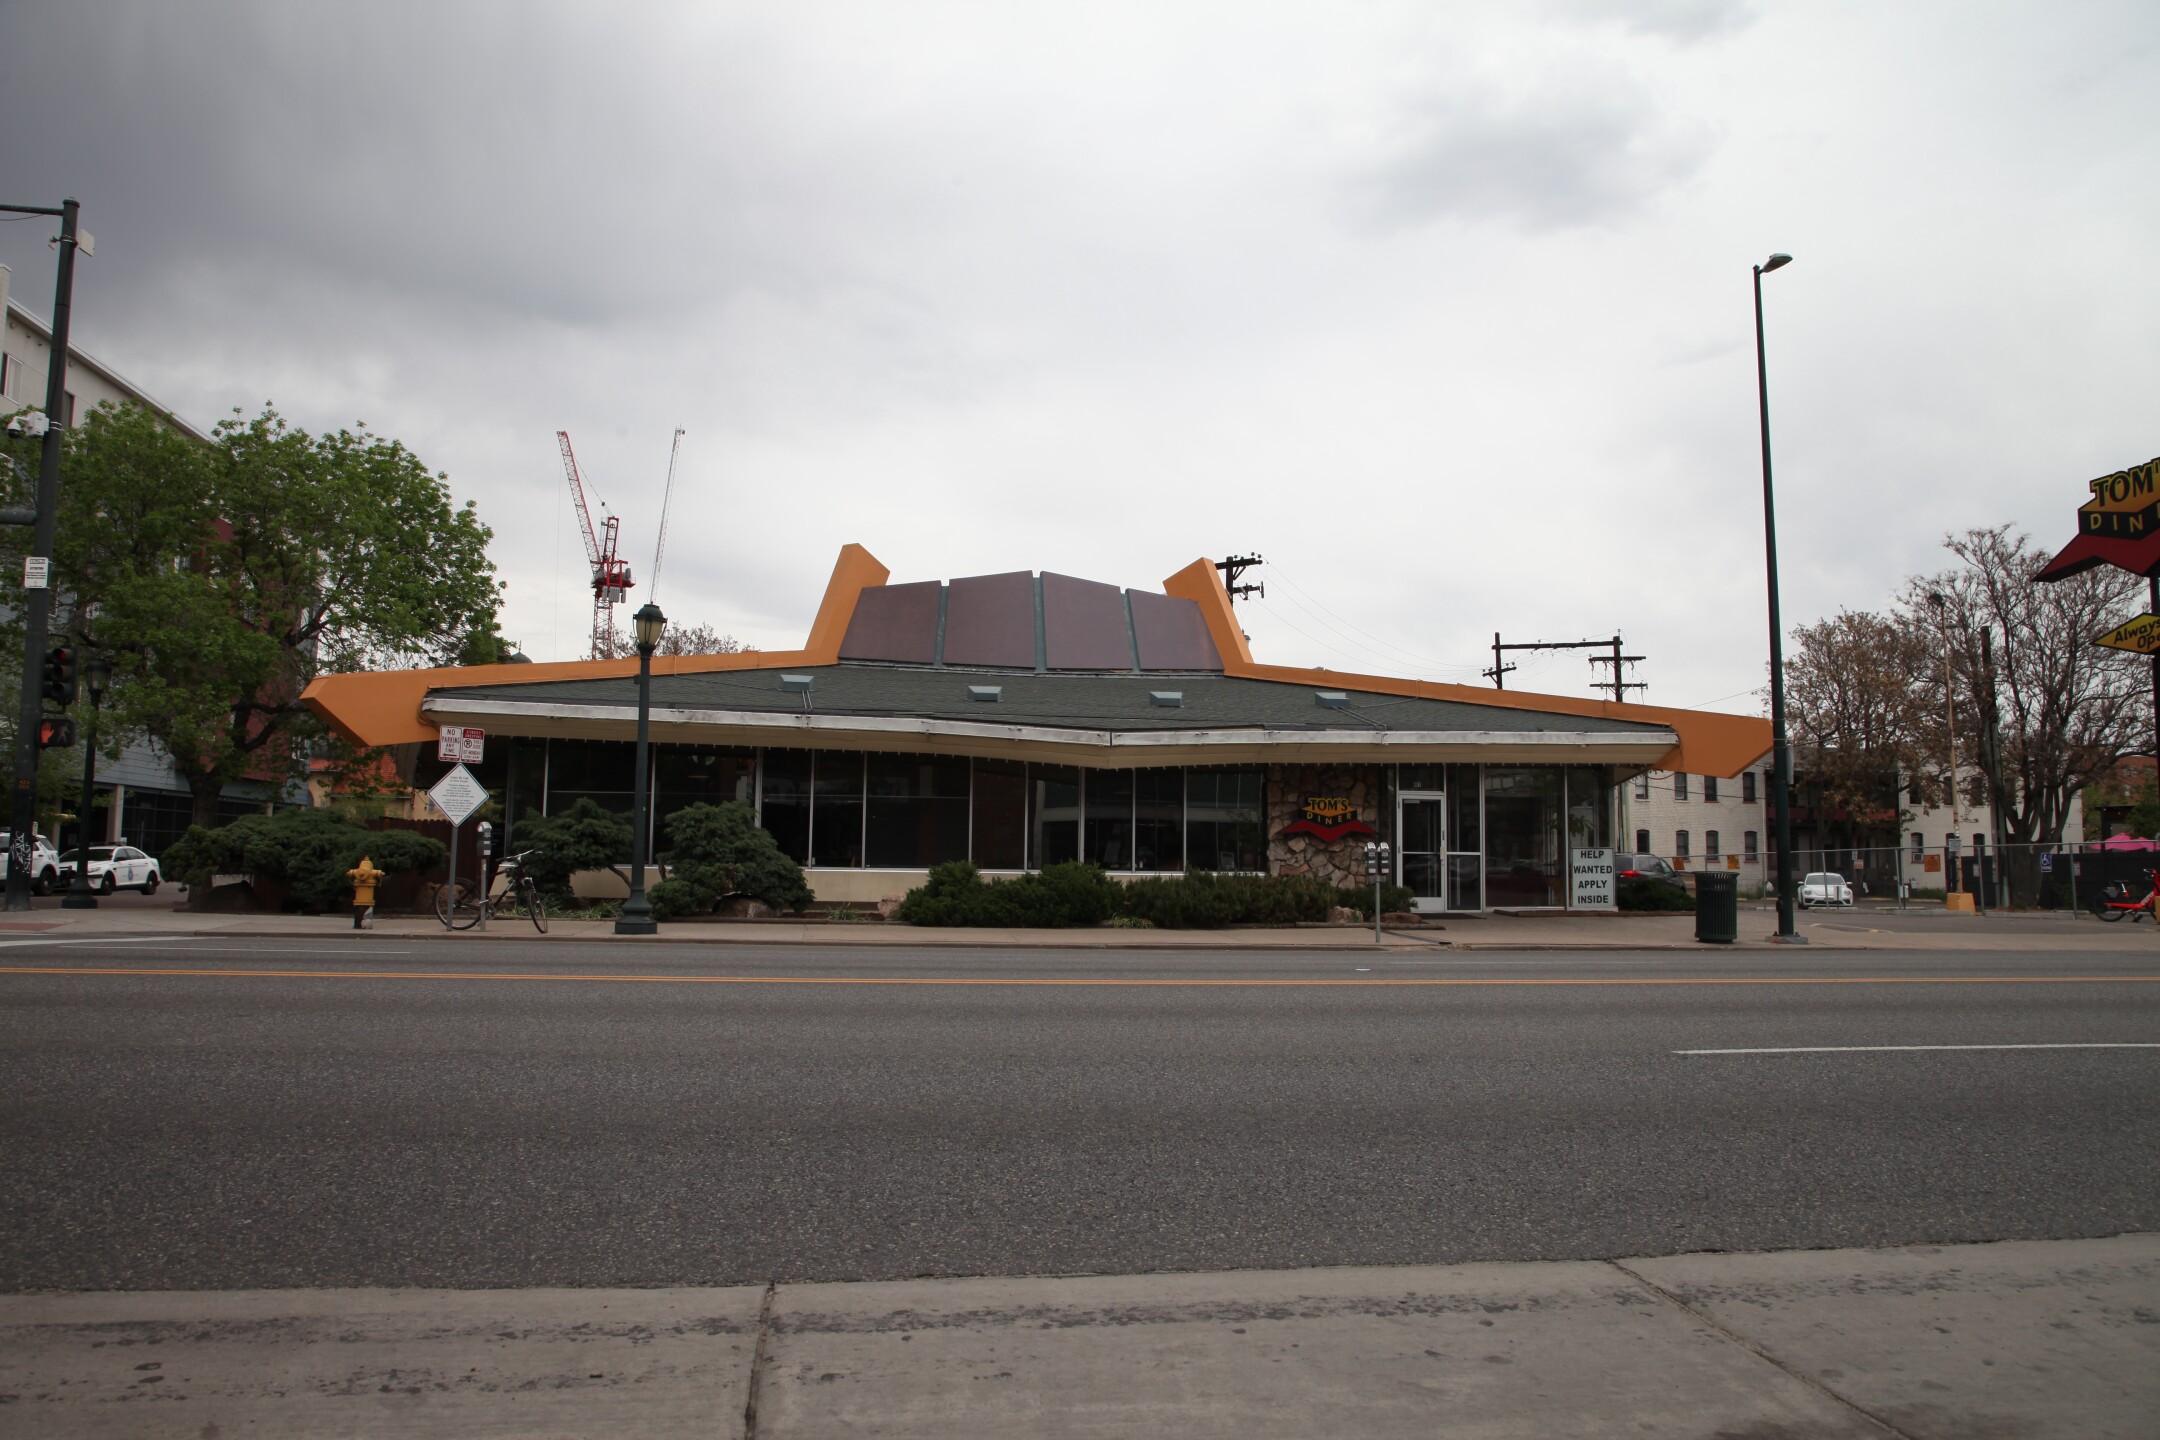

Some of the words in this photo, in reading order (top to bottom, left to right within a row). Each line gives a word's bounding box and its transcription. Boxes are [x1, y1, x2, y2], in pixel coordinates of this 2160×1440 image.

[2089, 459, 2160, 507] TOM'
[2090, 503, 2160, 533] DIN
[447, 728, 456, 736] NO
[442, 736, 460, 744] PARKING
[1308, 797, 1349, 811] TOM'S
[1306, 812, 1353, 825] DINER
[1580, 850, 1604, 859] HELP
[1573, 865, 1613, 874] WANTED
[1578, 880, 1607, 889] APPLY
[1577, 895, 1609, 904] INSIDE
